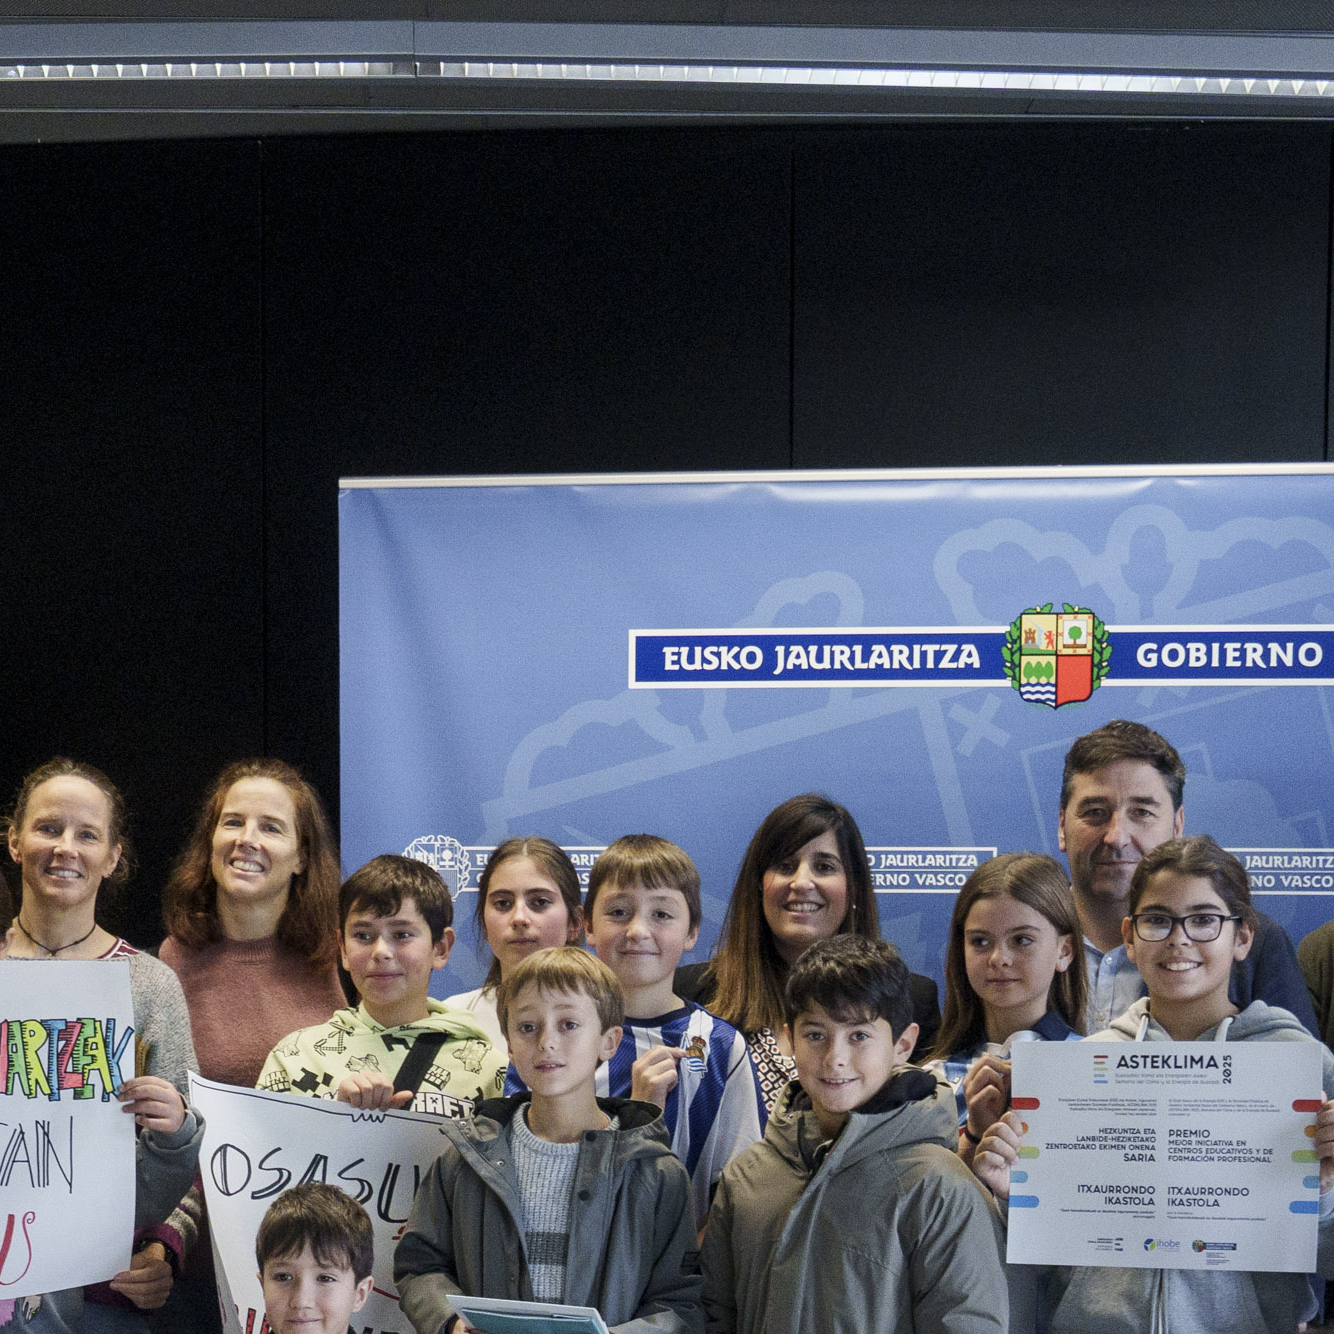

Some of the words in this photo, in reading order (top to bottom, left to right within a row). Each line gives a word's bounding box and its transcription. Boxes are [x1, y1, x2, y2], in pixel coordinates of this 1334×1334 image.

[662, 645, 763, 671] EUSKO
[773, 644, 980, 675] JAURLARITZA
[1136, 641, 1323, 669] GOBIERNO
[880, 854, 978, 869] JAURLARITZA
[914, 874, 967, 886] VASCO
[1280, 875, 1334, 888] VASCO
[1116, 1054, 1219, 1069] ASTEKLIMA
[1222, 1054, 1232, 1084] 2025
[1098, 1127, 1141, 1135] HEZKUNTZA
[1168, 1129, 1210, 1139] PREMIO
[1076, 1135, 1156, 1143] LANBIDE-HEZIKETAKO
[1098, 1143, 1126, 1151] EKIMEN
[1205, 1147, 1253, 1155] EDUCATIVOS
[1123, 1153, 1156, 1162] SARIA
[1217, 1155, 1272, 1163] PROFESIONAL
[210, 1143, 420, 1224] OSASU
[1077, 1184, 1156, 1195] ITXAURRONDO
[1167, 1186, 1250, 1197] ITXAURRONDO
[1104, 1196, 1155, 1206] IKASTOLA
[1167, 1198, 1220, 1207] IKASTOLA
[1156, 1238, 1181, 1248] ihobe
